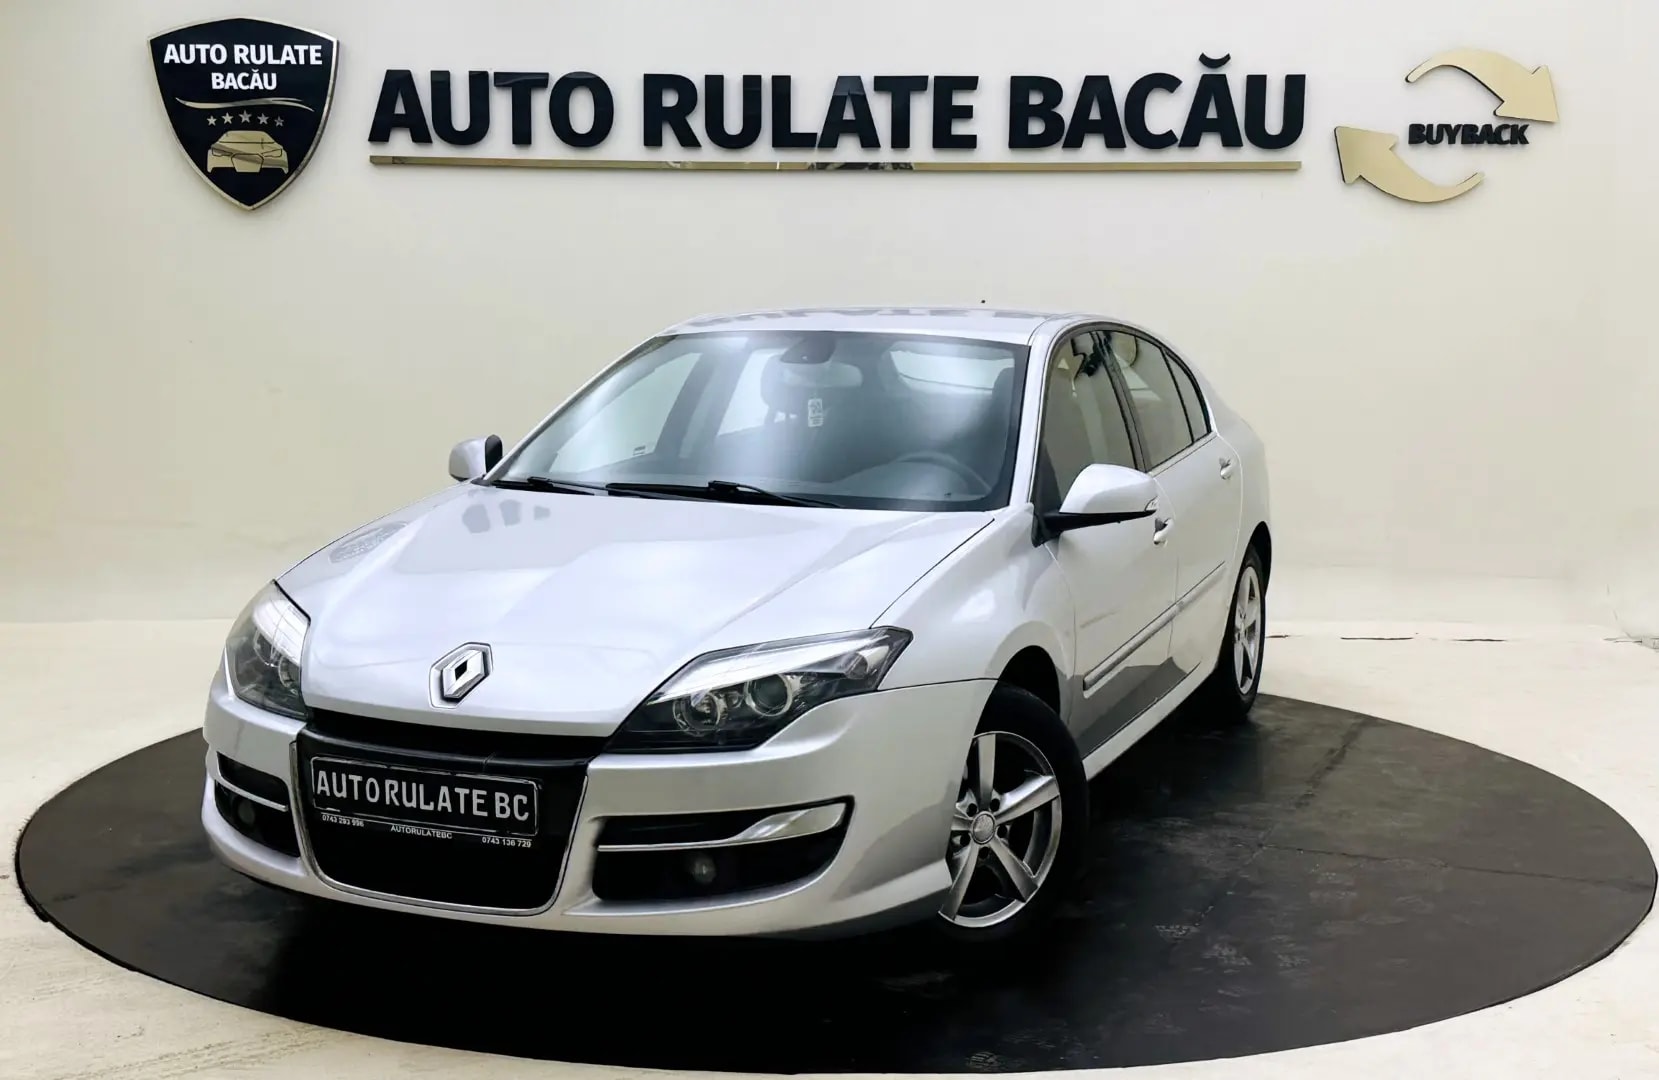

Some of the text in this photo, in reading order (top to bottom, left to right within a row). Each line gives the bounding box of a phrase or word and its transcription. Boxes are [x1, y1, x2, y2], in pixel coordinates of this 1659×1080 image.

[163, 44, 323, 65] AUTO RULATE
[211, 68, 277, 90] BACĂU
[368, 52, 1306, 149] AUTO RULATE BACĂU
[1408, 123, 1530, 145] BUYBACK
[494, 791, 529, 821] BC
[390, 824, 453, 840] AUTORULATEBC
